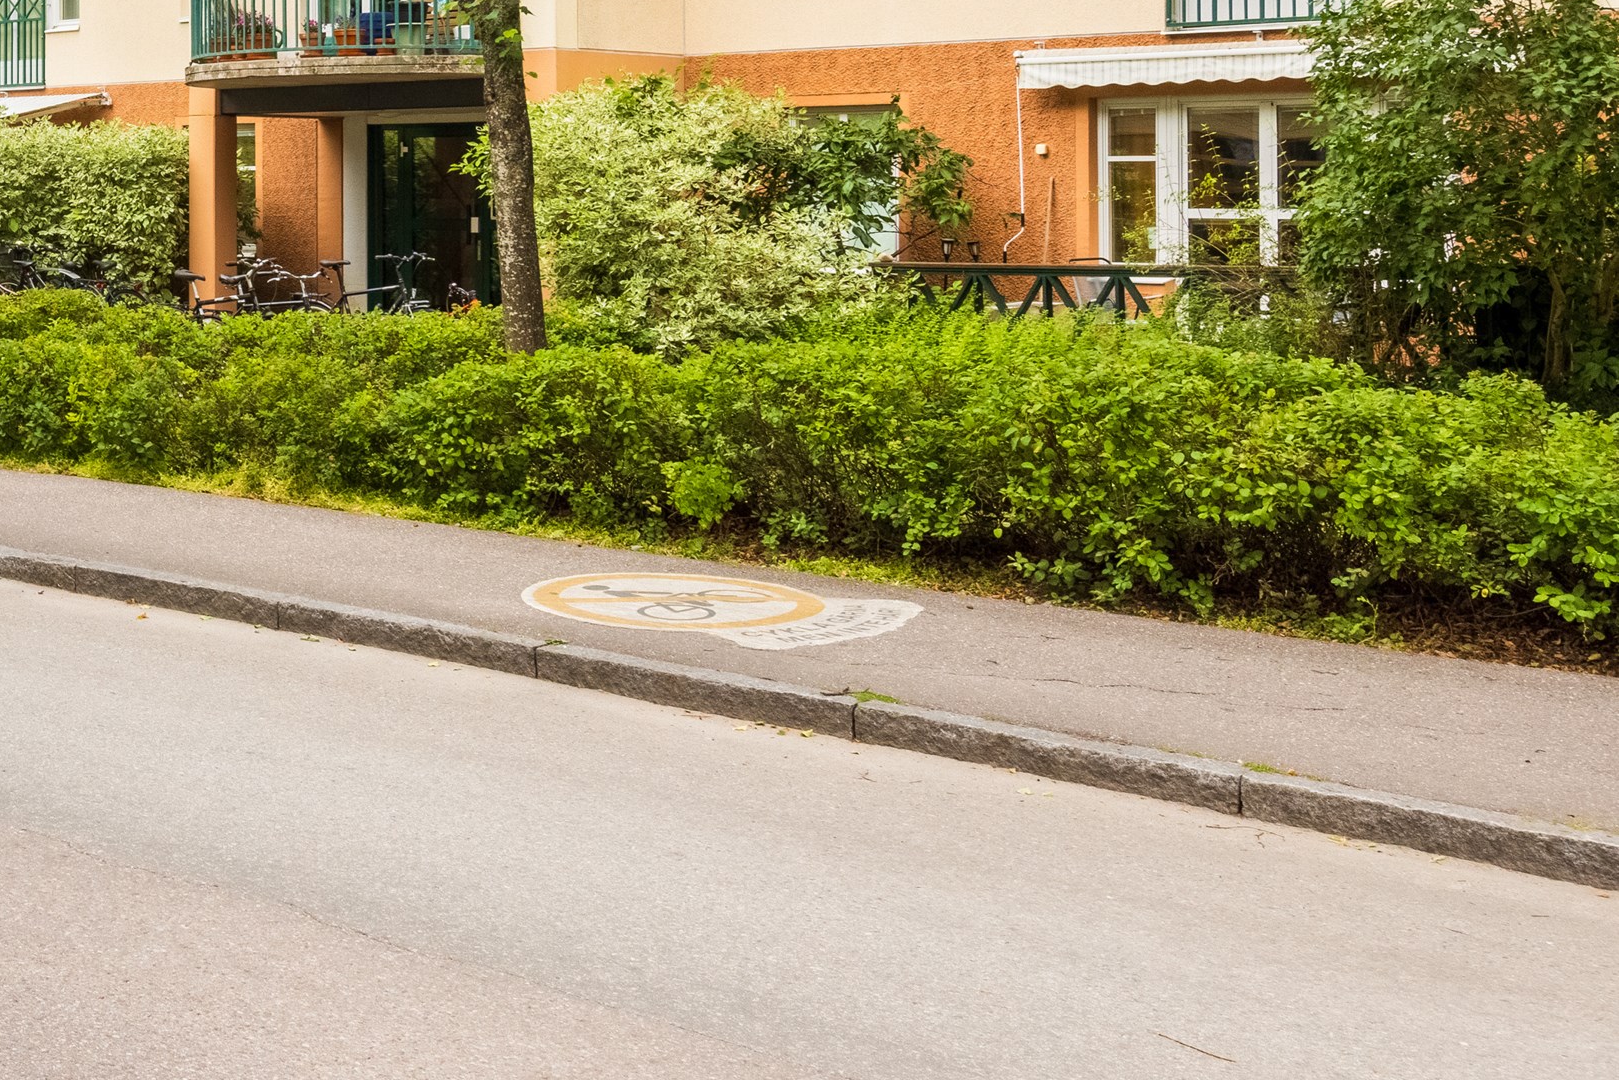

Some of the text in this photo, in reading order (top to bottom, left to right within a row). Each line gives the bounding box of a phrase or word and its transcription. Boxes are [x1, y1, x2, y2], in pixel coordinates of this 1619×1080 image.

[741, 622, 835, 637] CYKLA
[775, 607, 902, 643] MEN INTE HÄR
